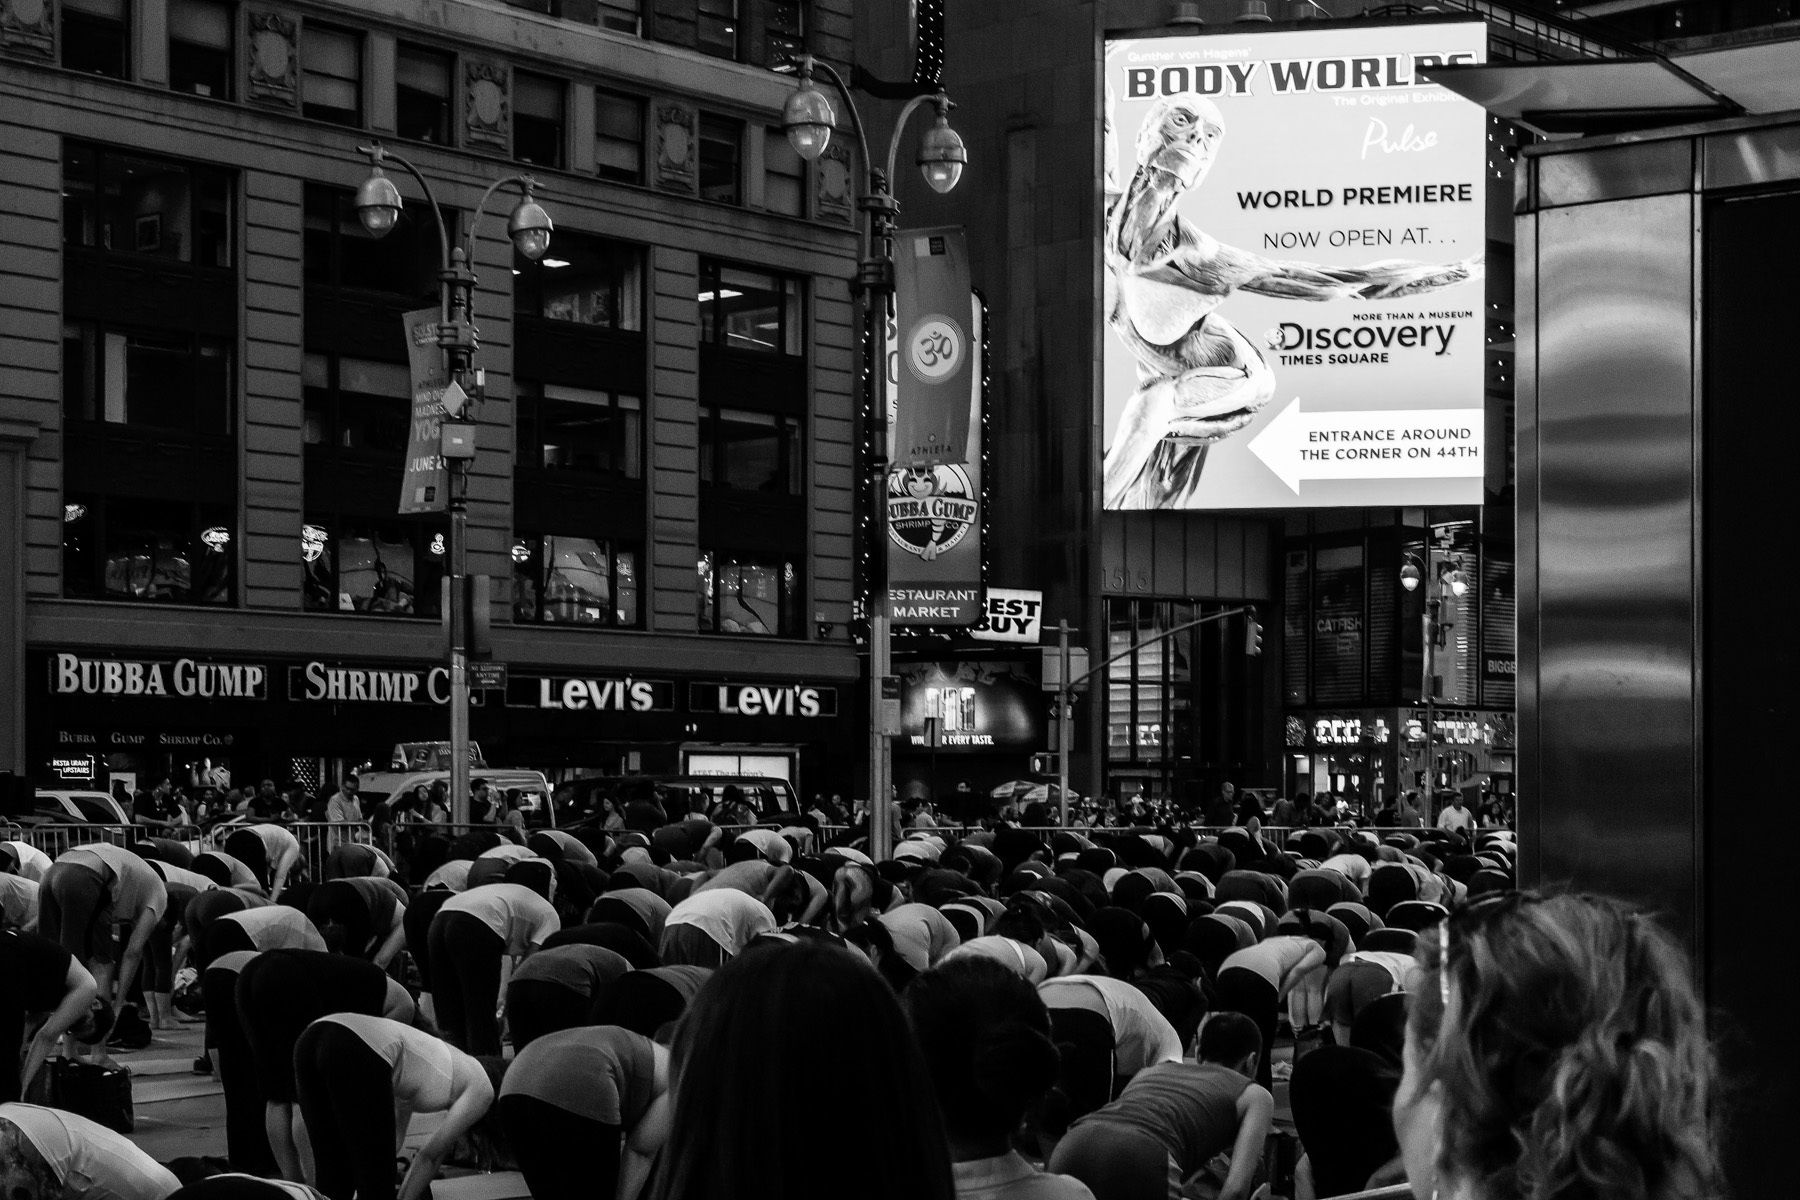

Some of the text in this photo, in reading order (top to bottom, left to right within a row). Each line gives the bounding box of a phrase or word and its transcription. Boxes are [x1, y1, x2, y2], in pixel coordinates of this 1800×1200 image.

[1128, 50, 1174, 62] Gunther
[1179, 51, 1200, 60] von
[1126, 62, 1256, 98] BODY
[1332, 96, 1356, 106] The
[1360, 93, 1407, 107] Original
[1361, 116, 1437, 160] Pulse
[1237, 183, 1473, 210] WORLD PREMIERE
[1264, 231, 1320, 249] NOW
[1329, 229, 1392, 247] OPEN
[1353, 313, 1382, 321] MORE
[1387, 312, 1414, 320] THAN
[1429, 310, 1473, 319] MUSEUM
[1279, 322, 1456, 356] Discovery
[1280, 352, 1390, 366] TIMES SQUARE
[414, 417, 440, 441] YOG
[1309, 427, 1471, 442] ENTRANCE AROUND
[1300, 446, 1478, 460] THE CORNER ON 44TH
[409, 456, 434, 472] JUNE
[888, 498, 976, 520] UBBA GUMP
[895, 519, 931, 530] SHRIMP
[888, 589, 978, 601] ESTAURANT
[893, 606, 961, 618] MARKET
[989, 598, 1041, 617] EST
[1316, 617, 1362, 633] CATFISH
[57, 653, 263, 697] BUBBA GUMP
[306, 661, 477, 705] SHRIMP C.
[59, 730, 97, 744] BUBBA
[110, 732, 145, 745] GUMP
[948, 736, 970, 745] EVERY
